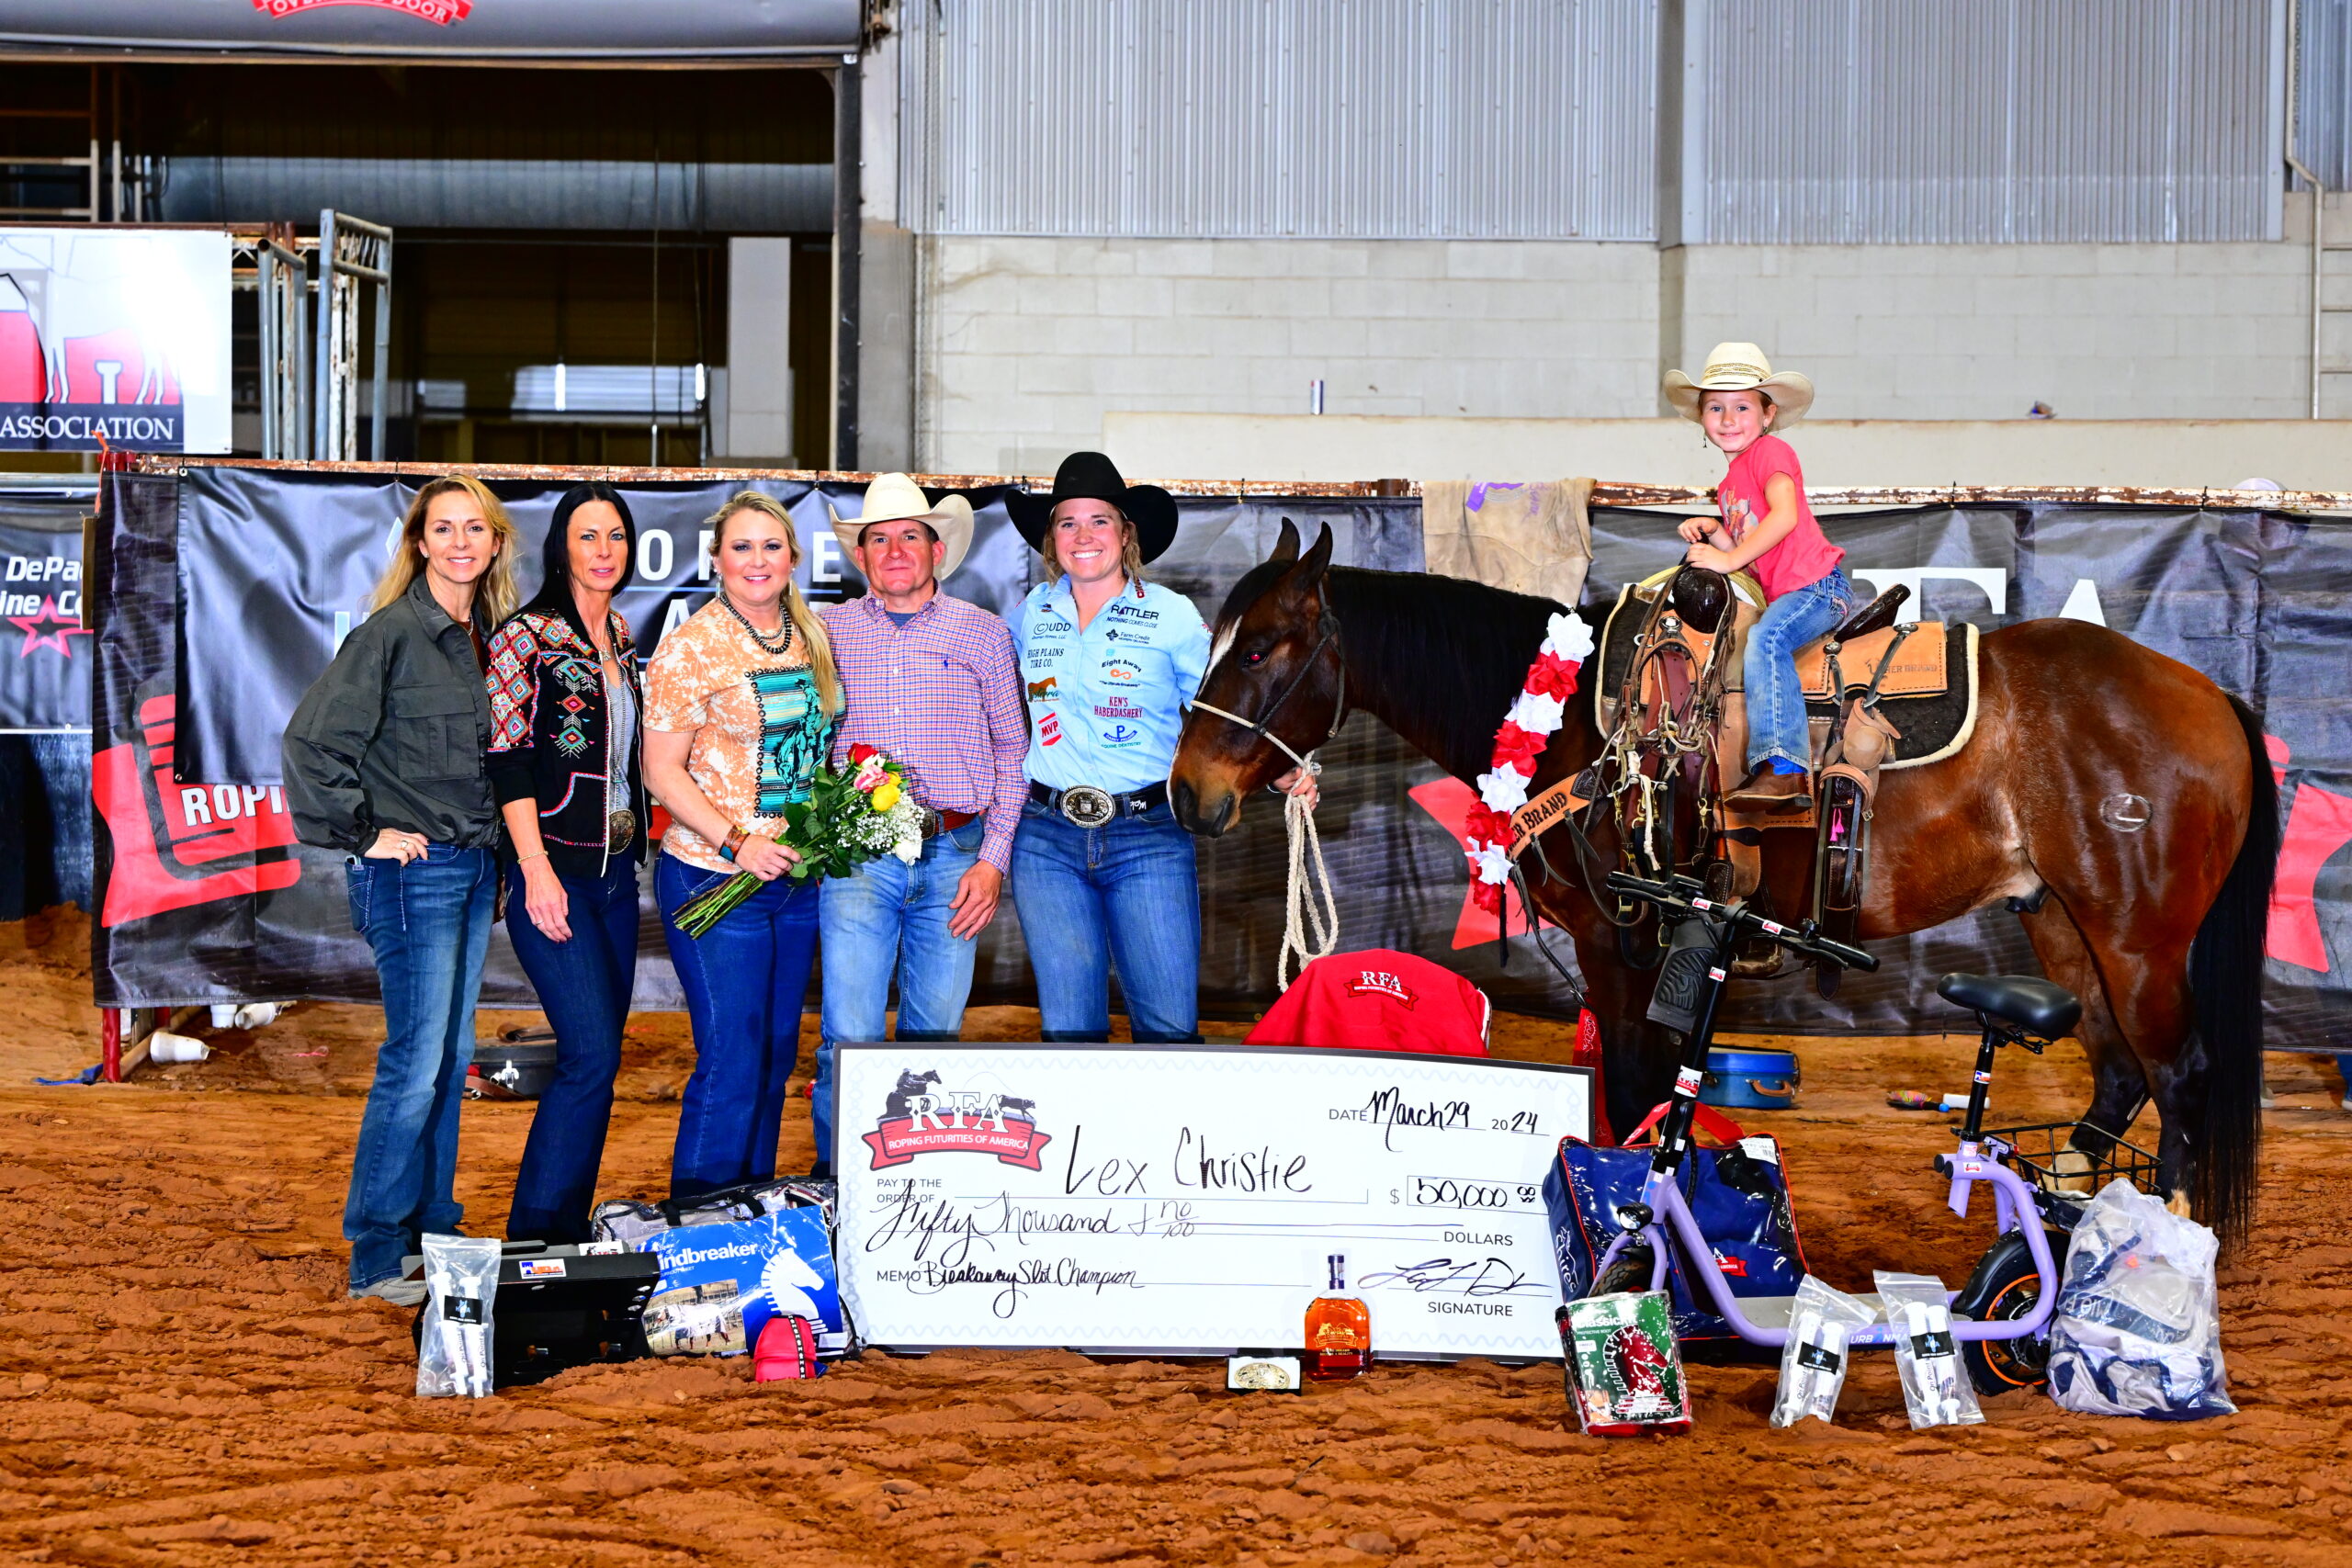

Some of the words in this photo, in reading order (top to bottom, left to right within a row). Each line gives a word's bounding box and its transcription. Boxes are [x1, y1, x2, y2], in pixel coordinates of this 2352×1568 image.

[0, 416, 175, 441] ASSOCIATION
[6, 557, 83, 581] DePa
[1111, 604, 1159, 620] RATTLER
[1027, 649, 1040, 659] HIGH
[1040, 648, 1065, 657] PLAINS
[1030, 660, 1043, 669] TIRE
[1043, 659, 1054, 668] CO.
[1102, 660, 1121, 668] Eight
[1123, 660, 1142, 672] Away
[1109, 696, 1128, 707] KEN'S
[1094, 705, 1143, 718] HABERDASHERY
[1041, 720, 1058, 738] MVP
[181, 784, 290, 827] ROPI
[1521, 792, 1567, 830] BRAND
[1361, 971, 1402, 992] RFA
[905, 1091, 1011, 1134] RFA
[1329, 1108, 1368, 1122] DATE
[1365, 1086, 1445, 1153] March
[1444, 1101, 1470, 1128] 29
[1491, 1118, 1509, 1131] 20
[1511, 1111, 1538, 1134] 24
[888, 1135, 923, 1150] ROPING
[924, 1134, 974, 1145] FUTURITIES
[975, 1134, 988, 1145] OF
[990, 1135, 1029, 1150] AMERICA
[1065, 1124, 1148, 1196] Lex
[1175, 1126, 1312, 1192] Christie
[876, 1179, 899, 1188] PAY
[901, 1179, 916, 1188] TO
[920, 1179, 942, 1188] THE
[876, 1194, 916, 1203] ORDER
[920, 1194, 935, 1203] OF
[1389, 1189, 1400, 1204] $
[1417, 1178, 1508, 1209] 50,000
[1444, 1231, 1514, 1247] DOLLARS
[657, 1242, 758, 1270] indbreaker
[876, 1270, 921, 1281] MEMO
[1057, 1258, 1146, 1295] Champion
[1428, 1302, 1514, 1317] SIGNATURE
